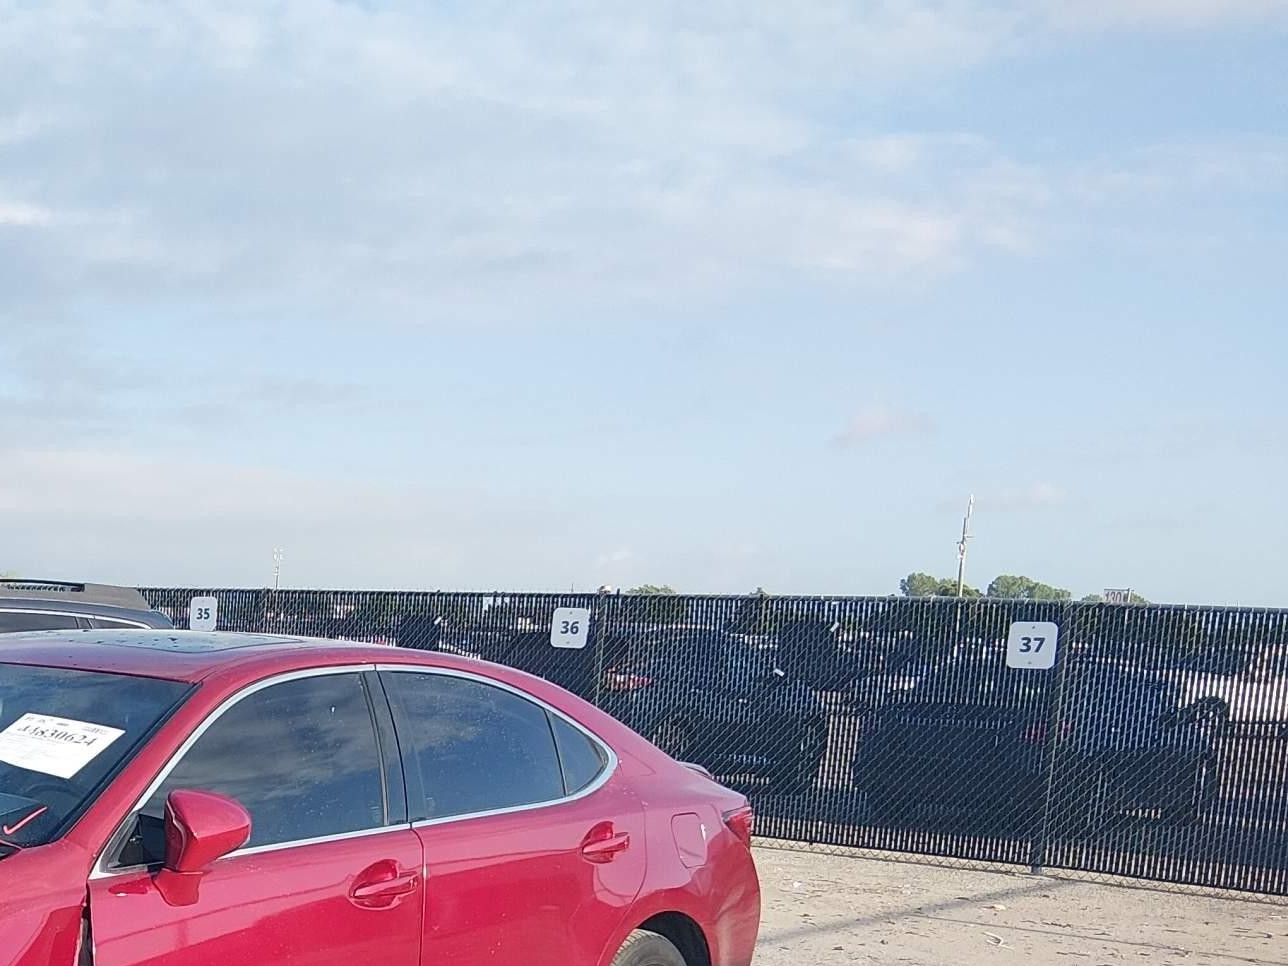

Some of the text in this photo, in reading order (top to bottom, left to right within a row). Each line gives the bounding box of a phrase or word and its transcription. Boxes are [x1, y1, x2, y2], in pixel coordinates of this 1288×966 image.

[196, 608, 210, 620] 35
[560, 620, 580, 634] 36
[1019, 637, 1046, 653] 37
